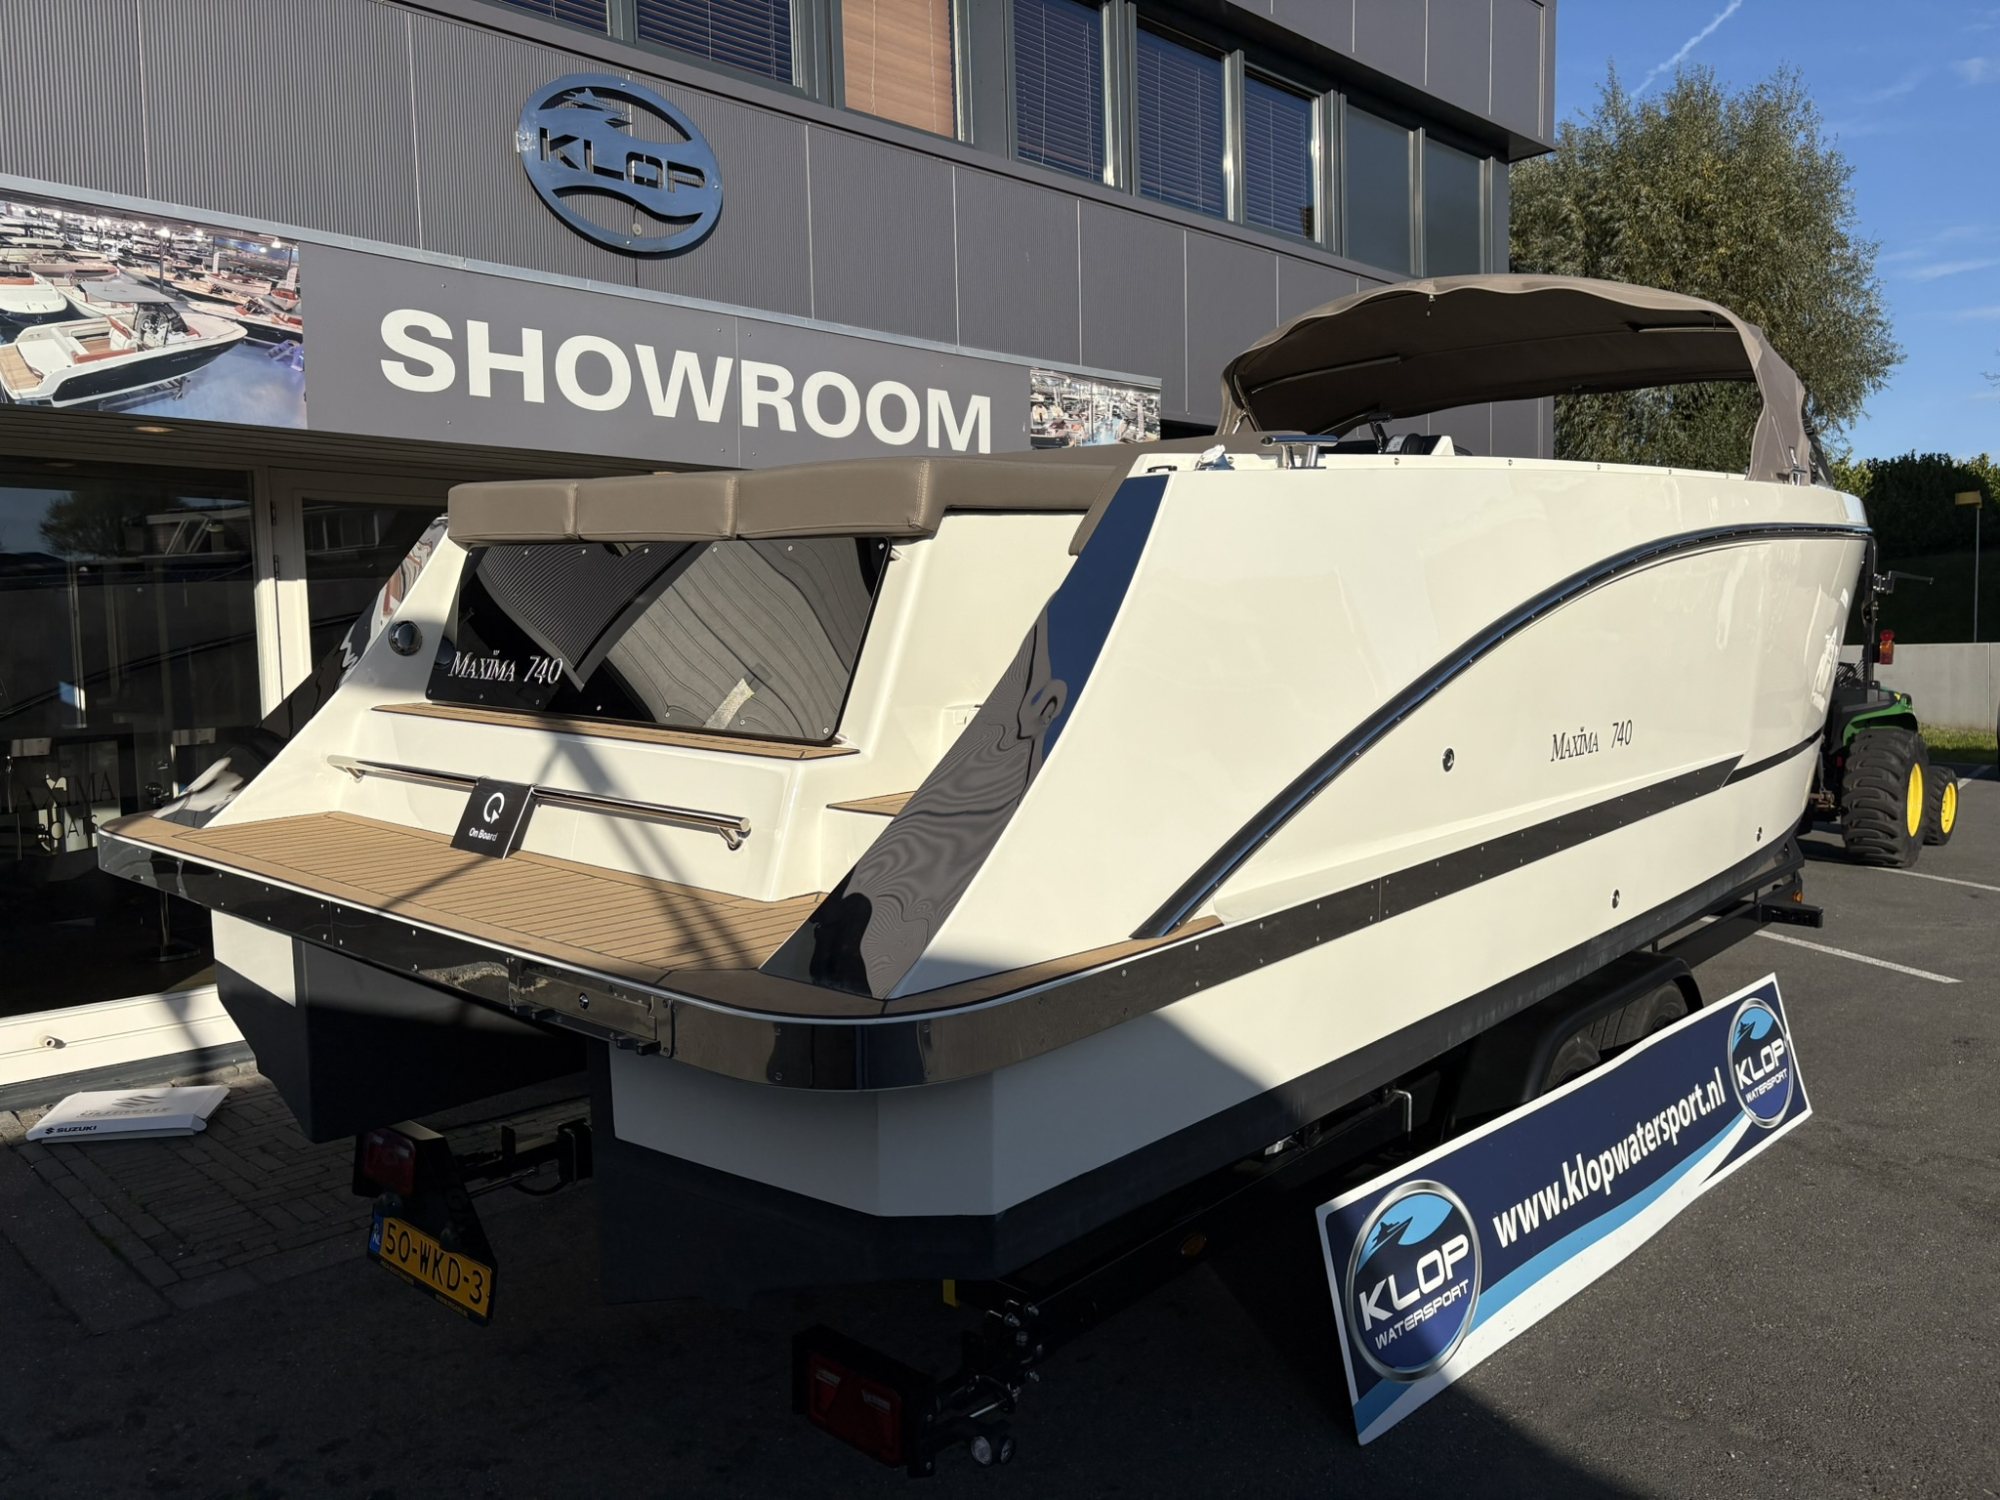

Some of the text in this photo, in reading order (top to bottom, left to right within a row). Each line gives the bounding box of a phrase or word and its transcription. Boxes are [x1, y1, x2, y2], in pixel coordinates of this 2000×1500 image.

[539, 126, 706, 194] KLOP
[380, 308, 992, 455] SHOWROOM
[523, 654, 564, 685] 740
[1611, 719, 1633, 749] 740
[0, 770, 117, 814] AXIMA
[468, 827, 499, 842] On Board
[1735, 1037, 1786, 1090] KLOP
[1745, 1067, 1788, 1104] WATERSPORT
[56, 1125, 97, 1133] SUZUKI
[1492, 1066, 1727, 1249] www.klopwatersport.nl
[371, 1235, 381, 1246] NL
[385, 1222, 484, 1305] 50-WKD-3
[1359, 1233, 1469, 1332] KLOP
[1375, 1278, 1469, 1350] WATERSPORT
